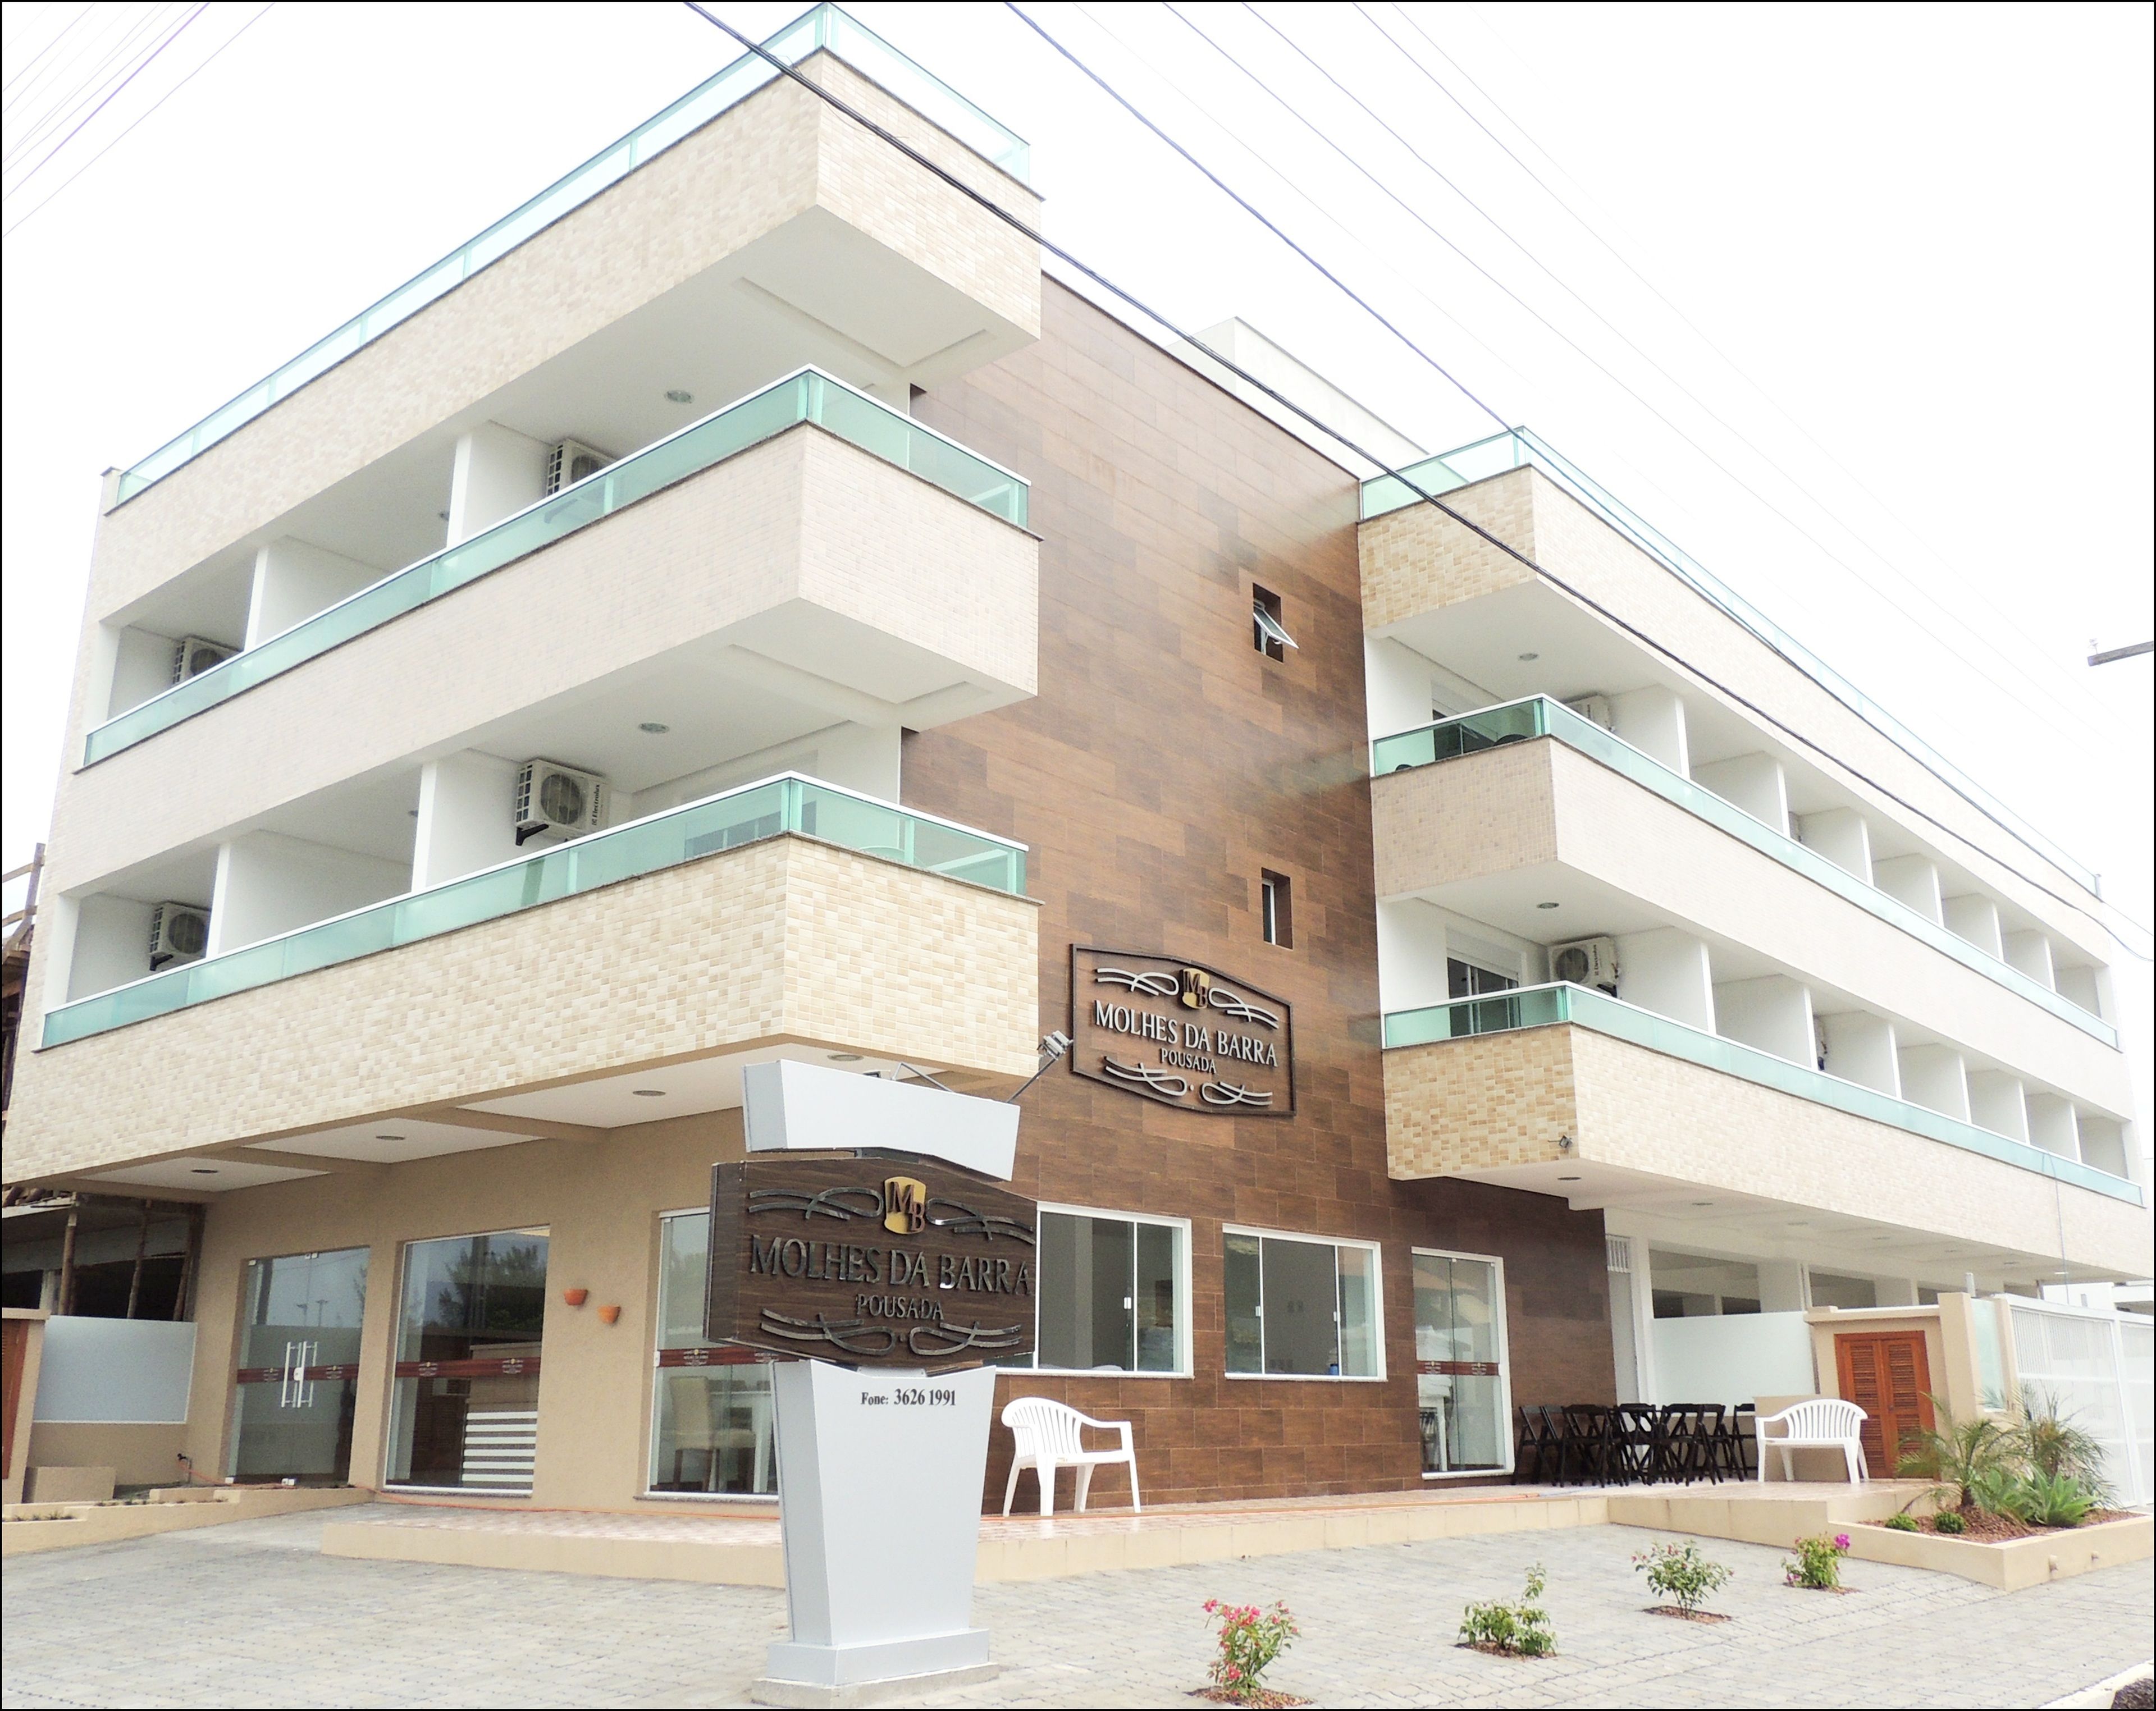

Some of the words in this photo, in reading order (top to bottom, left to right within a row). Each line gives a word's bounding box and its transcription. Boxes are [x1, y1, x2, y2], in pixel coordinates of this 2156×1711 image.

[592, 784, 600, 817] Electrolux
[1095, 1000, 1178, 1045] MOLHES
[1184, 1023, 1211, 1051] DA
[1217, 1030, 1278, 1067] BARRA
[1161, 1047, 1217, 1073] POUSADA
[750, 1235, 881, 1283] MOLHES
[890, 1250, 930, 1288] DA
[939, 1253, 1034, 1296] BARRA
[856, 1293, 944, 1320] POUSADA
[861, 1392, 889, 1405] Fone:
[894, 1388, 925, 1406] 3626
[928, 1388, 956, 1406] 1991
